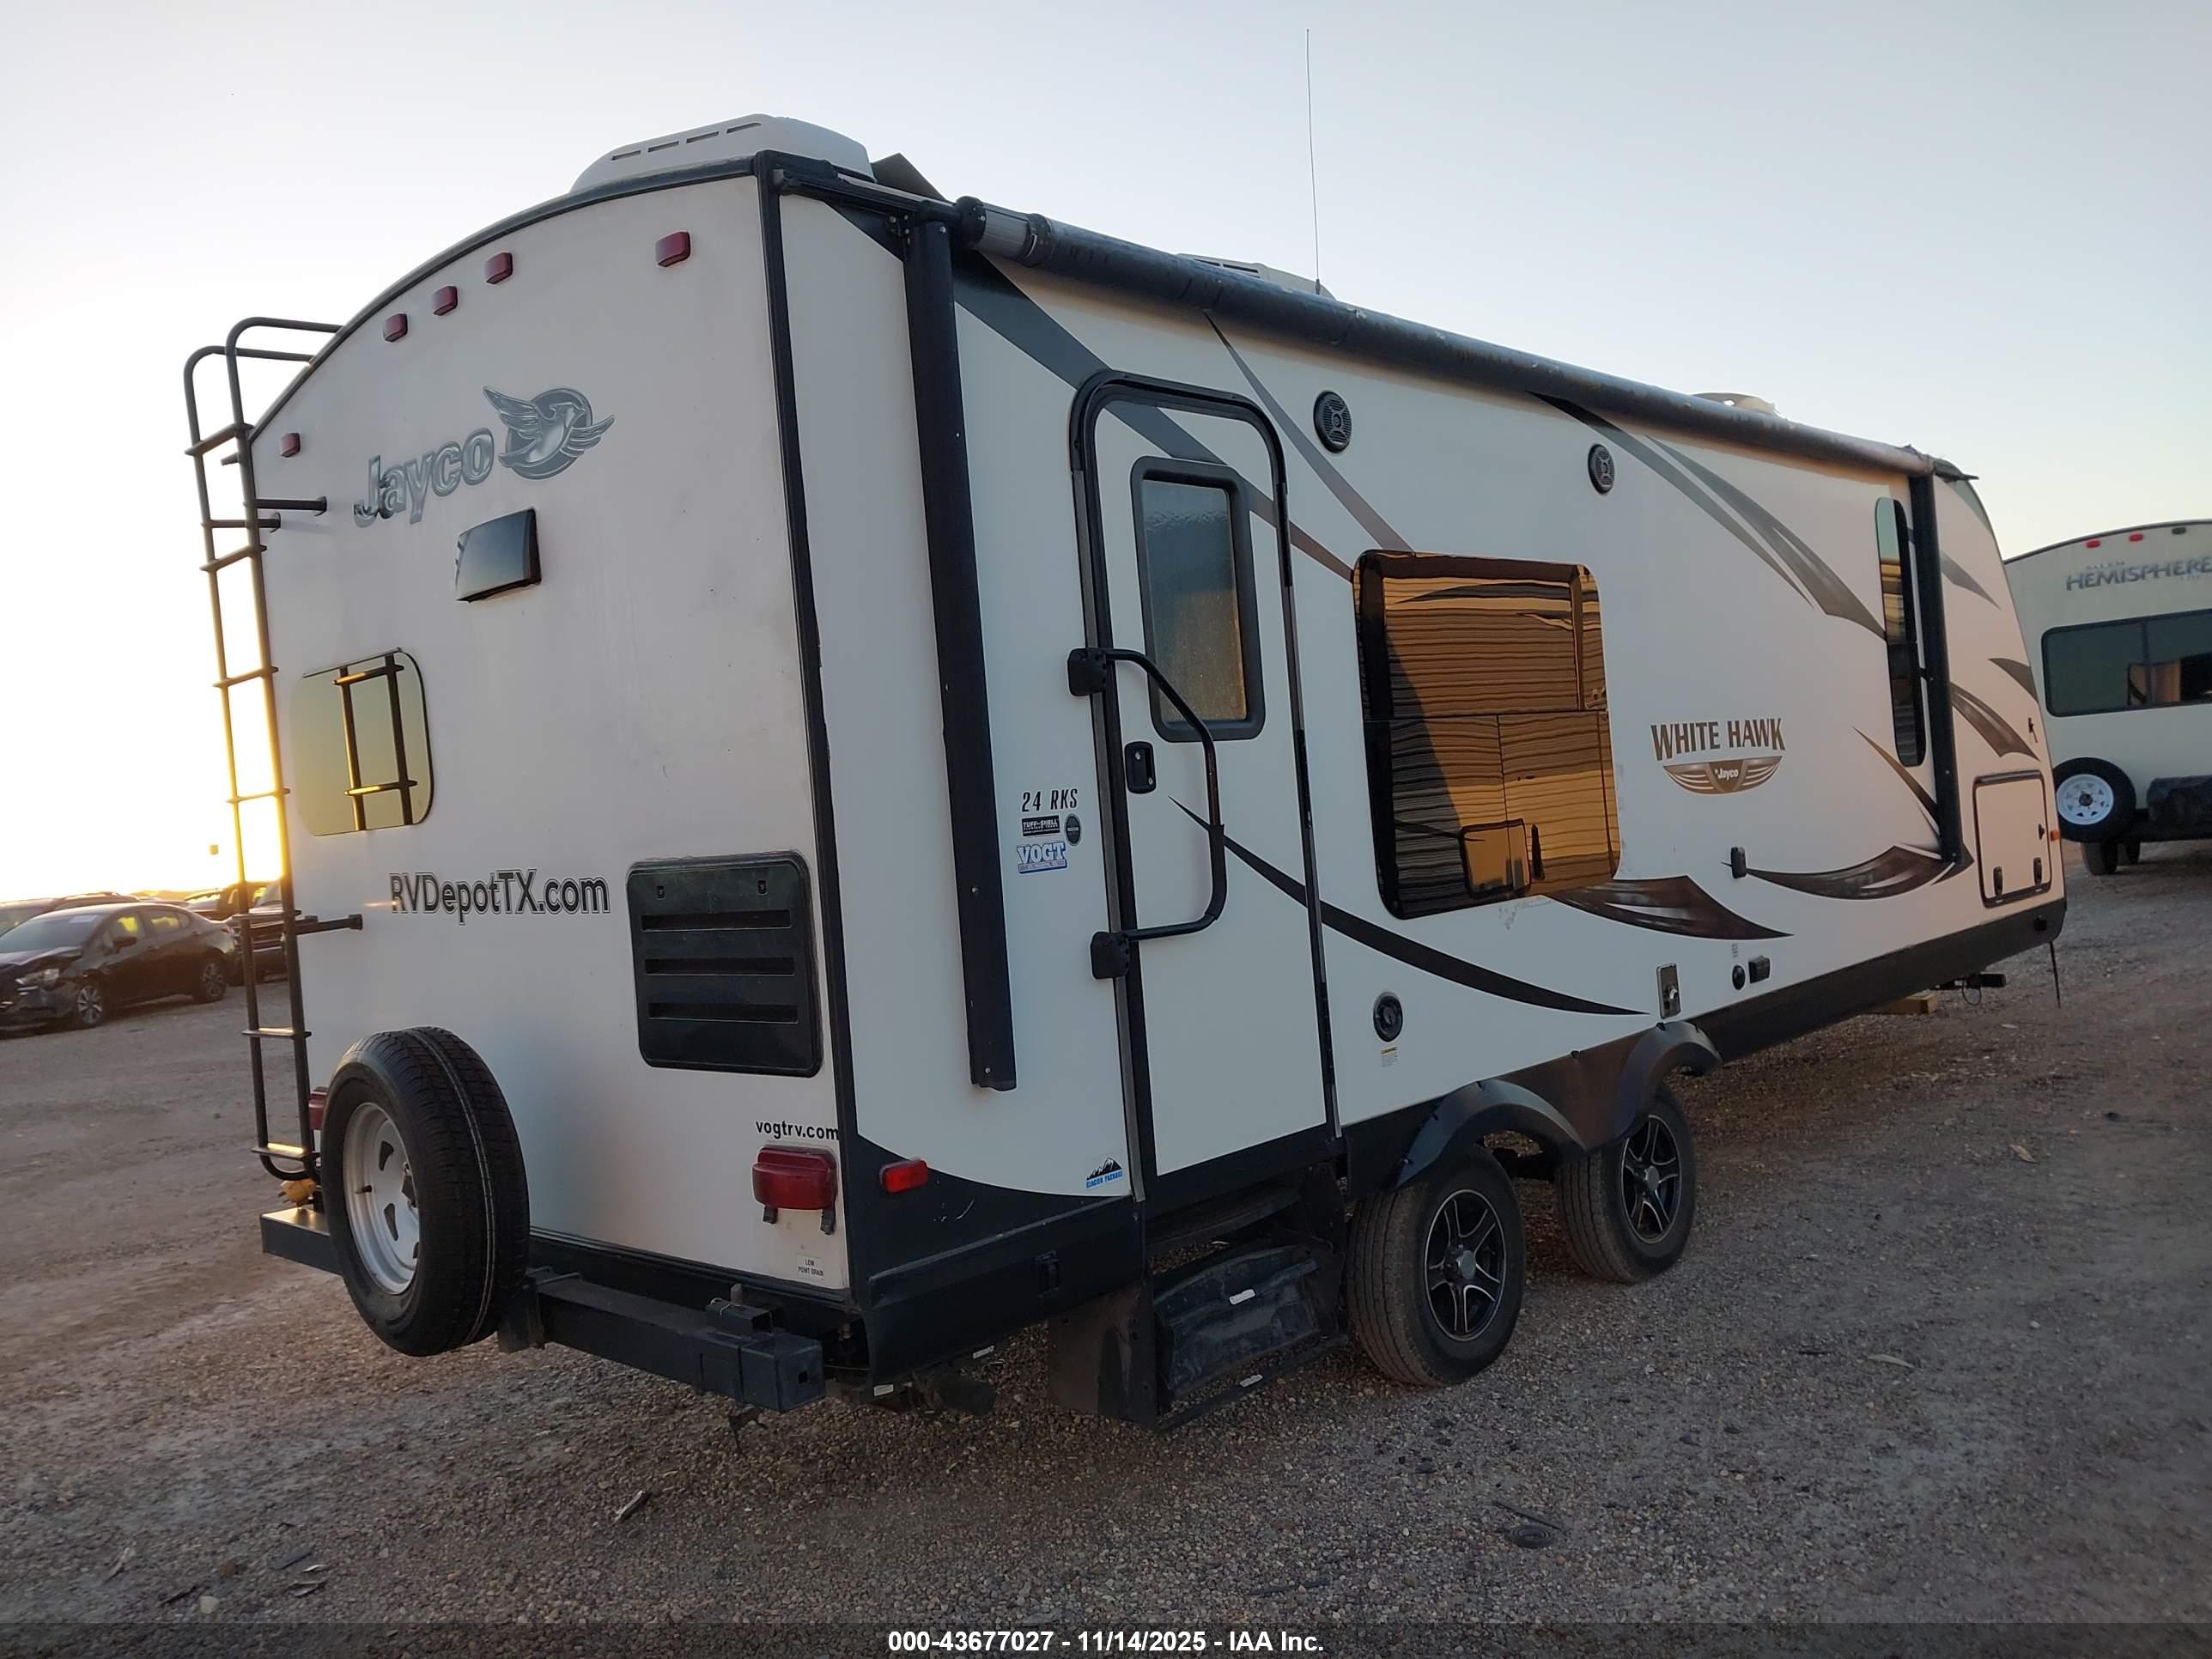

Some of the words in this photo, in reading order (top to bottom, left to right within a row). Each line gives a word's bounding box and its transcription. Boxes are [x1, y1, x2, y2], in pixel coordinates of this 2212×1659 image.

[353, 428, 495, 528] Jayco
[2065, 556, 2212, 592] HEMISPHERE
[1650, 720, 1721, 762] WHITE
[1727, 718, 1786, 751] HAWK
[1717, 767, 1739, 781] Jayco
[1021, 791, 1041, 812] 24
[1050, 788, 1078, 810] RKS
[1017, 842, 1066, 865] VOGT
[389, 868, 611, 927] RVDepotTX.com
[755, 1120, 839, 1140] vogtrv.com
[805, 1258, 815, 1267] LOW
